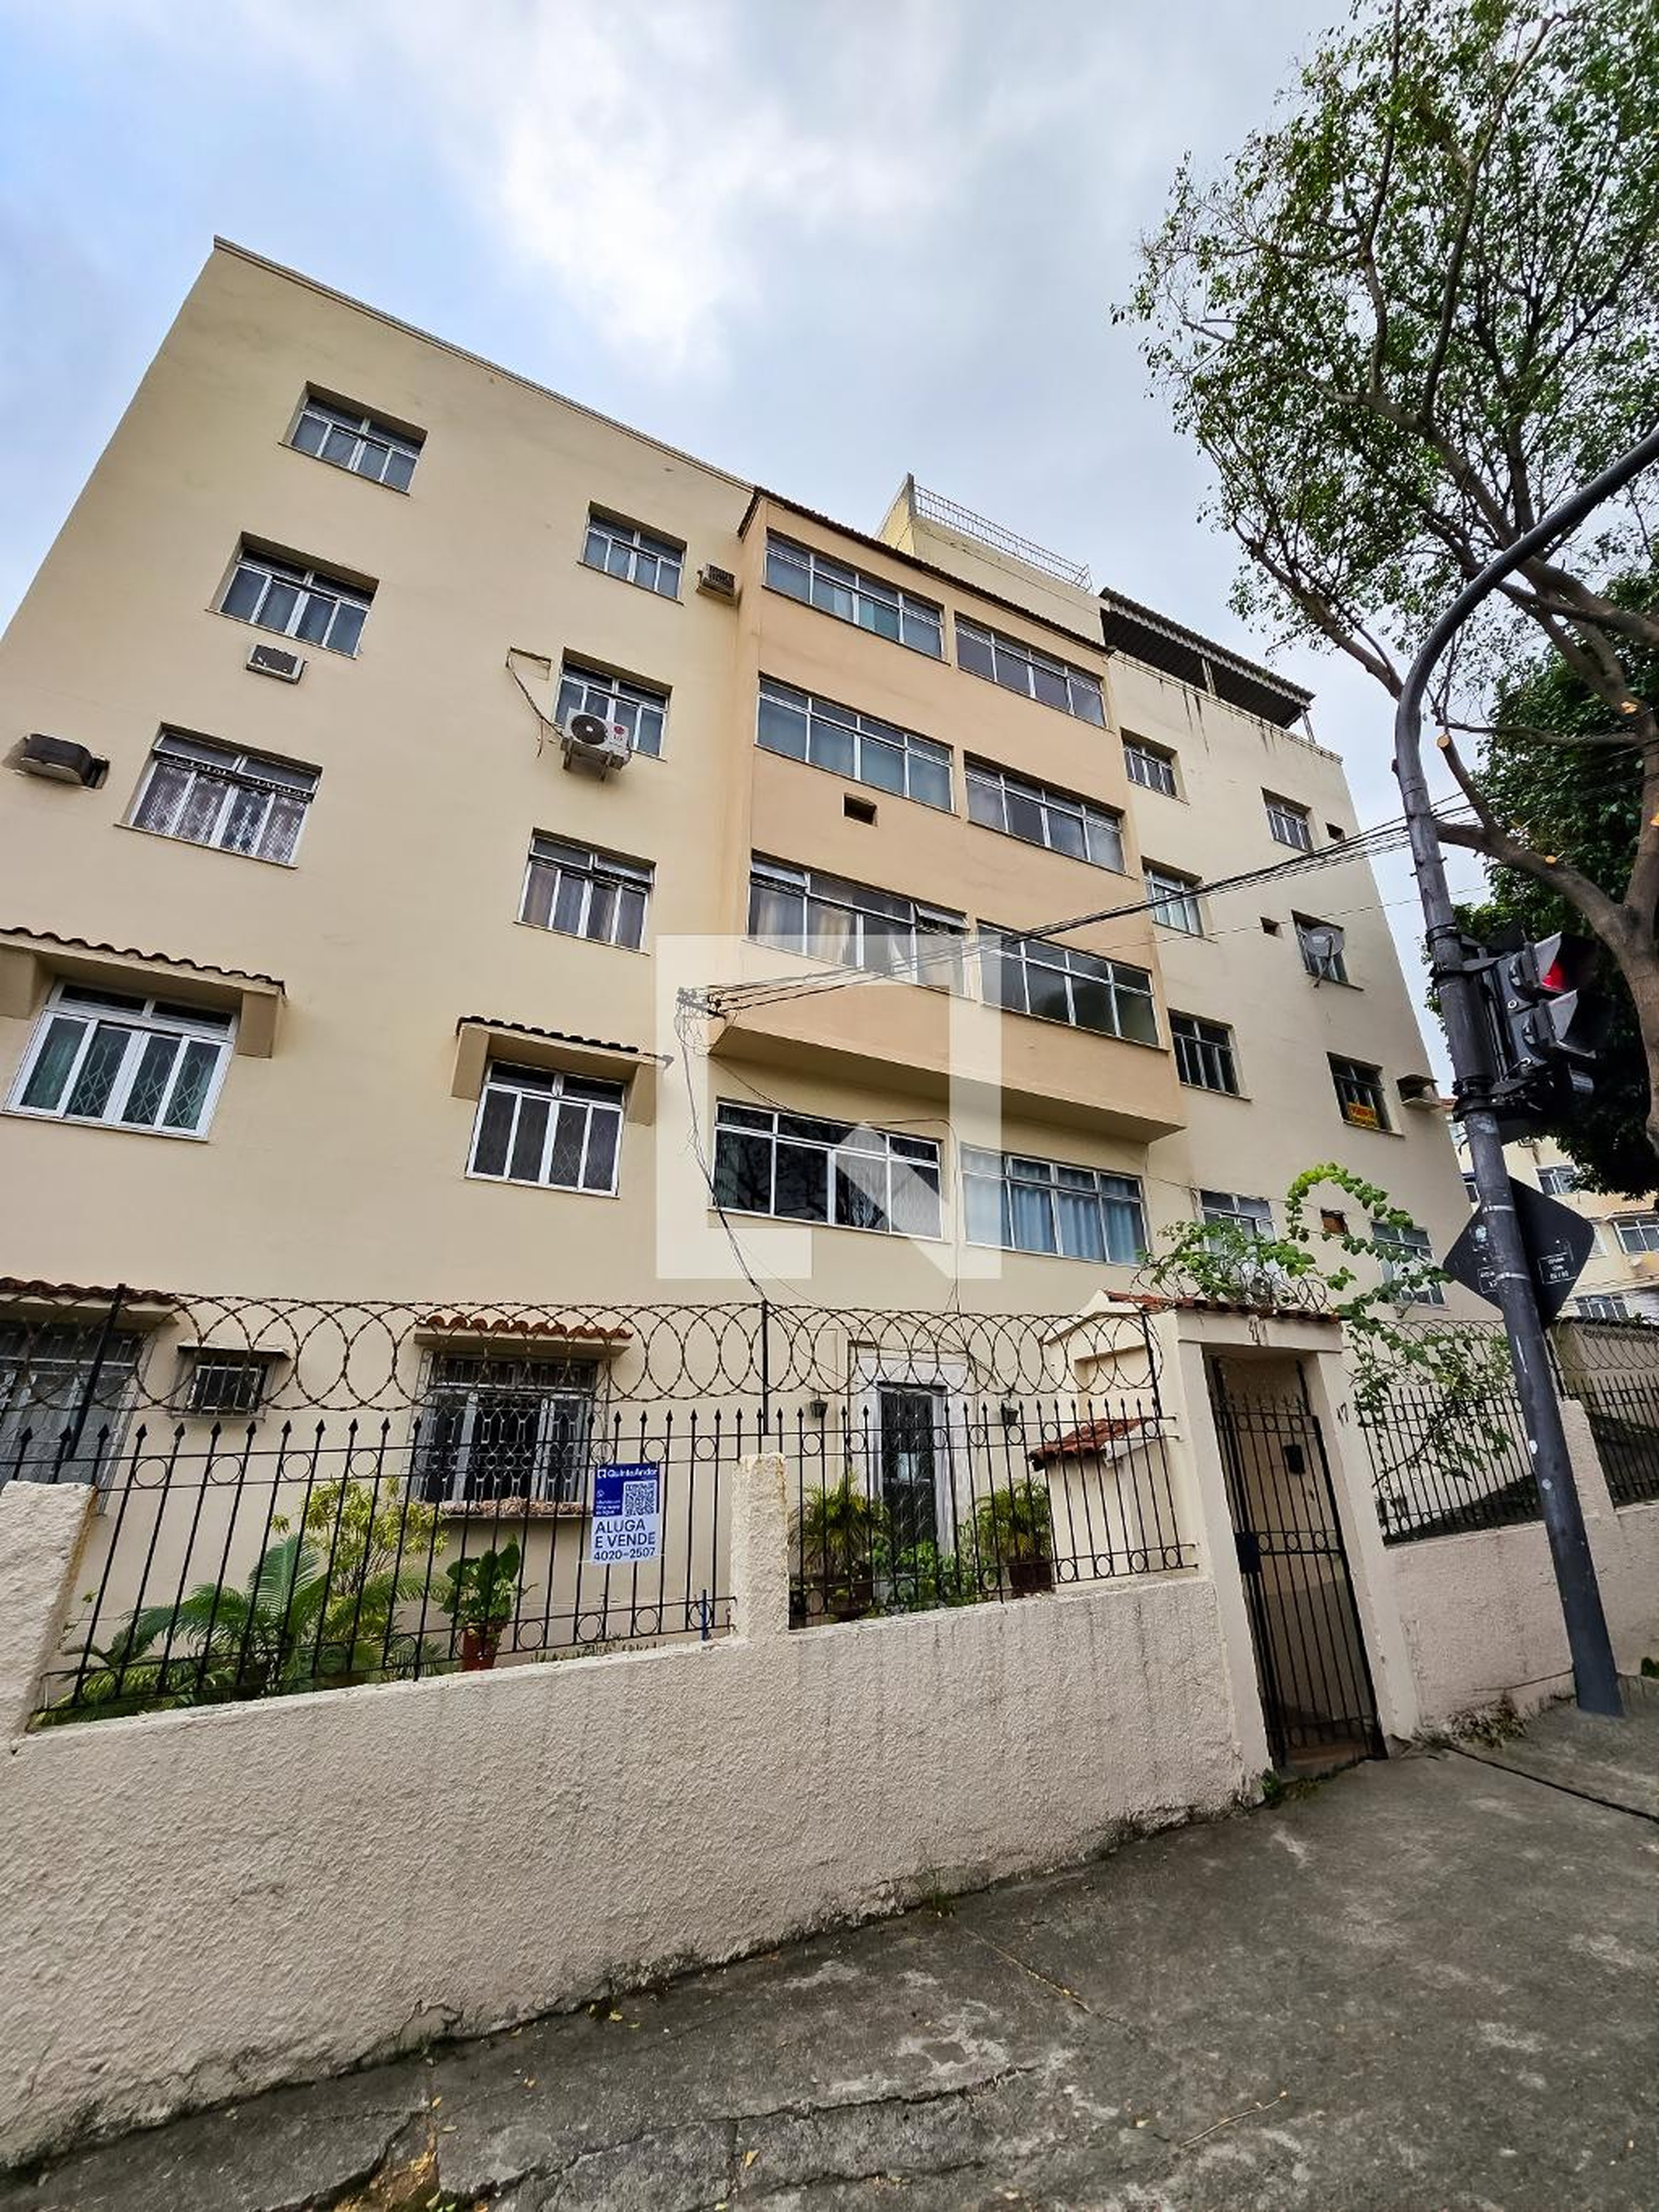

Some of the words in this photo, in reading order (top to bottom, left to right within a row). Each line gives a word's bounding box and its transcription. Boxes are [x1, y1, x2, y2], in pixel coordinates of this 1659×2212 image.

[595, 1518, 645, 1534] ALUGA
[595, 1535, 604, 1548] E
[607, 1532, 656, 1547] VENDE
[594, 1547, 656, 1561] 4020-2507
